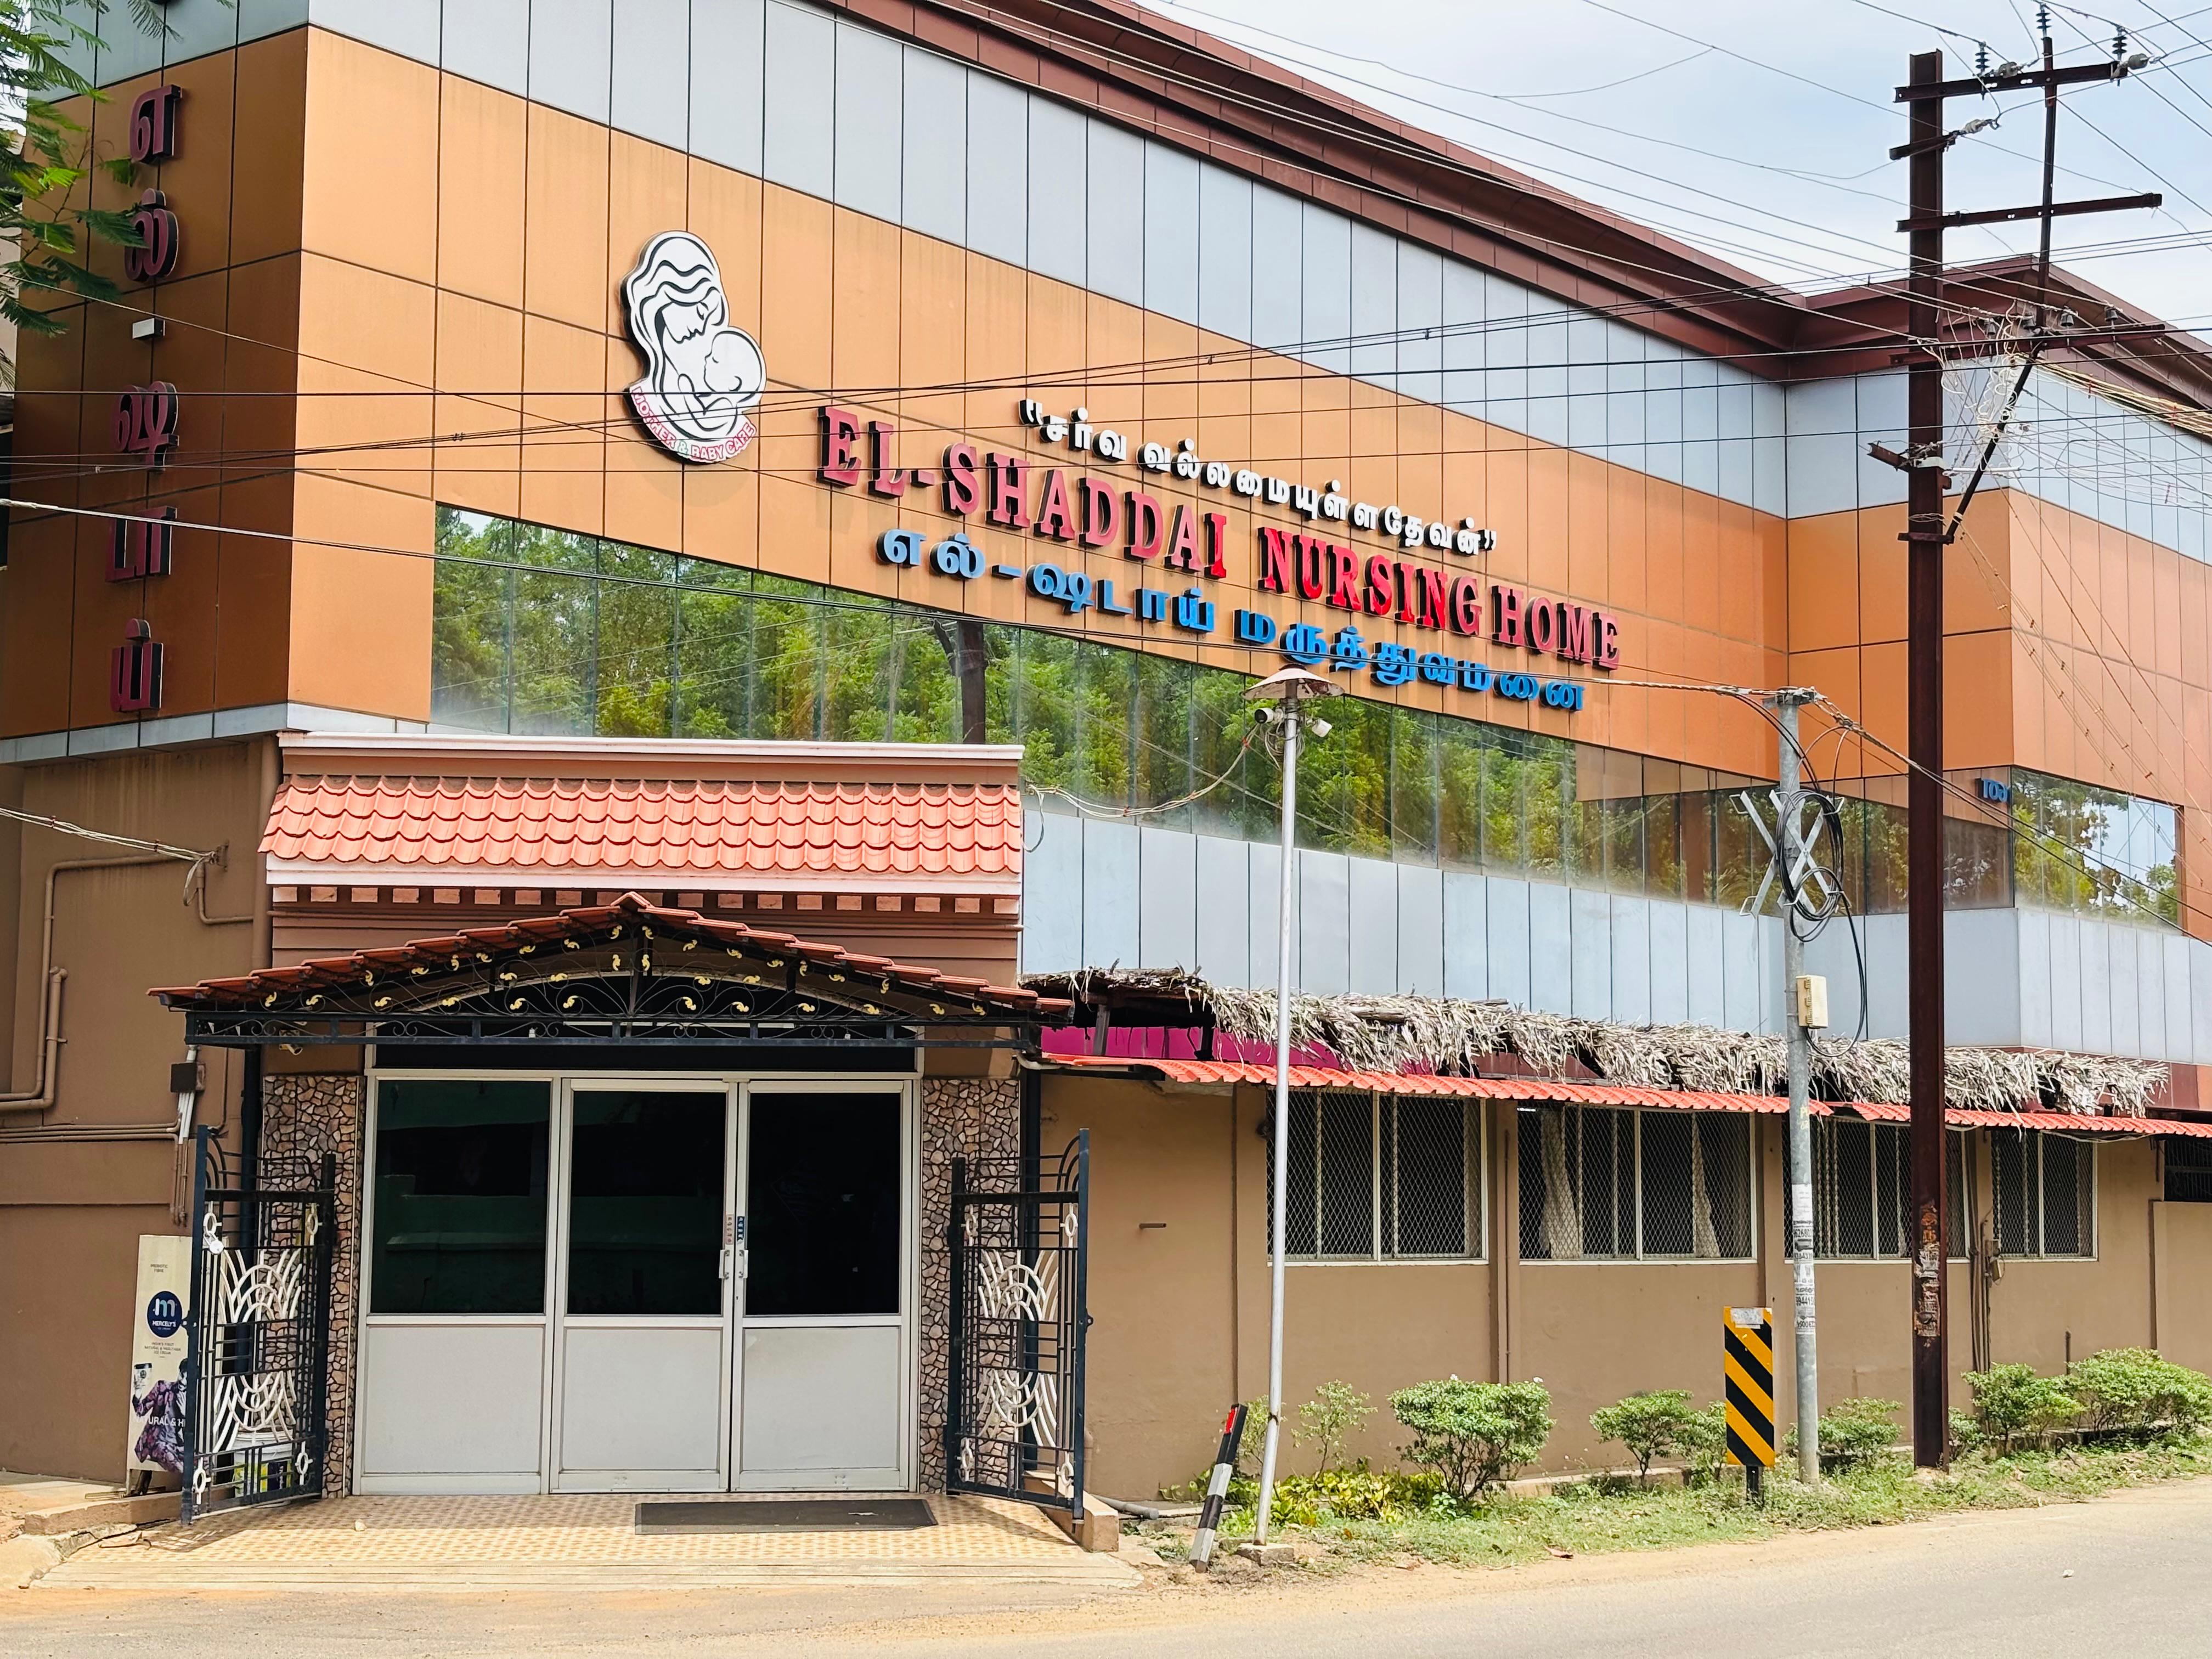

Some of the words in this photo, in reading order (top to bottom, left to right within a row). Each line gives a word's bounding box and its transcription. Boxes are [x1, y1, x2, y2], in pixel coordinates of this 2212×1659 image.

[631, 386, 676, 448] MOTHER
[678, 439, 688, 458] &
[691, 445, 724, 460] BABY
[725, 422, 755, 454] CARE
[817, 406, 1227, 579] EL-SHADDAI
[1257, 527, 1482, 636] NURSING
[1491, 585, 1620, 670] HOME
[152, 1319, 176, 1328] MERCELY'S
[170, 1418, 176, 1426] &
